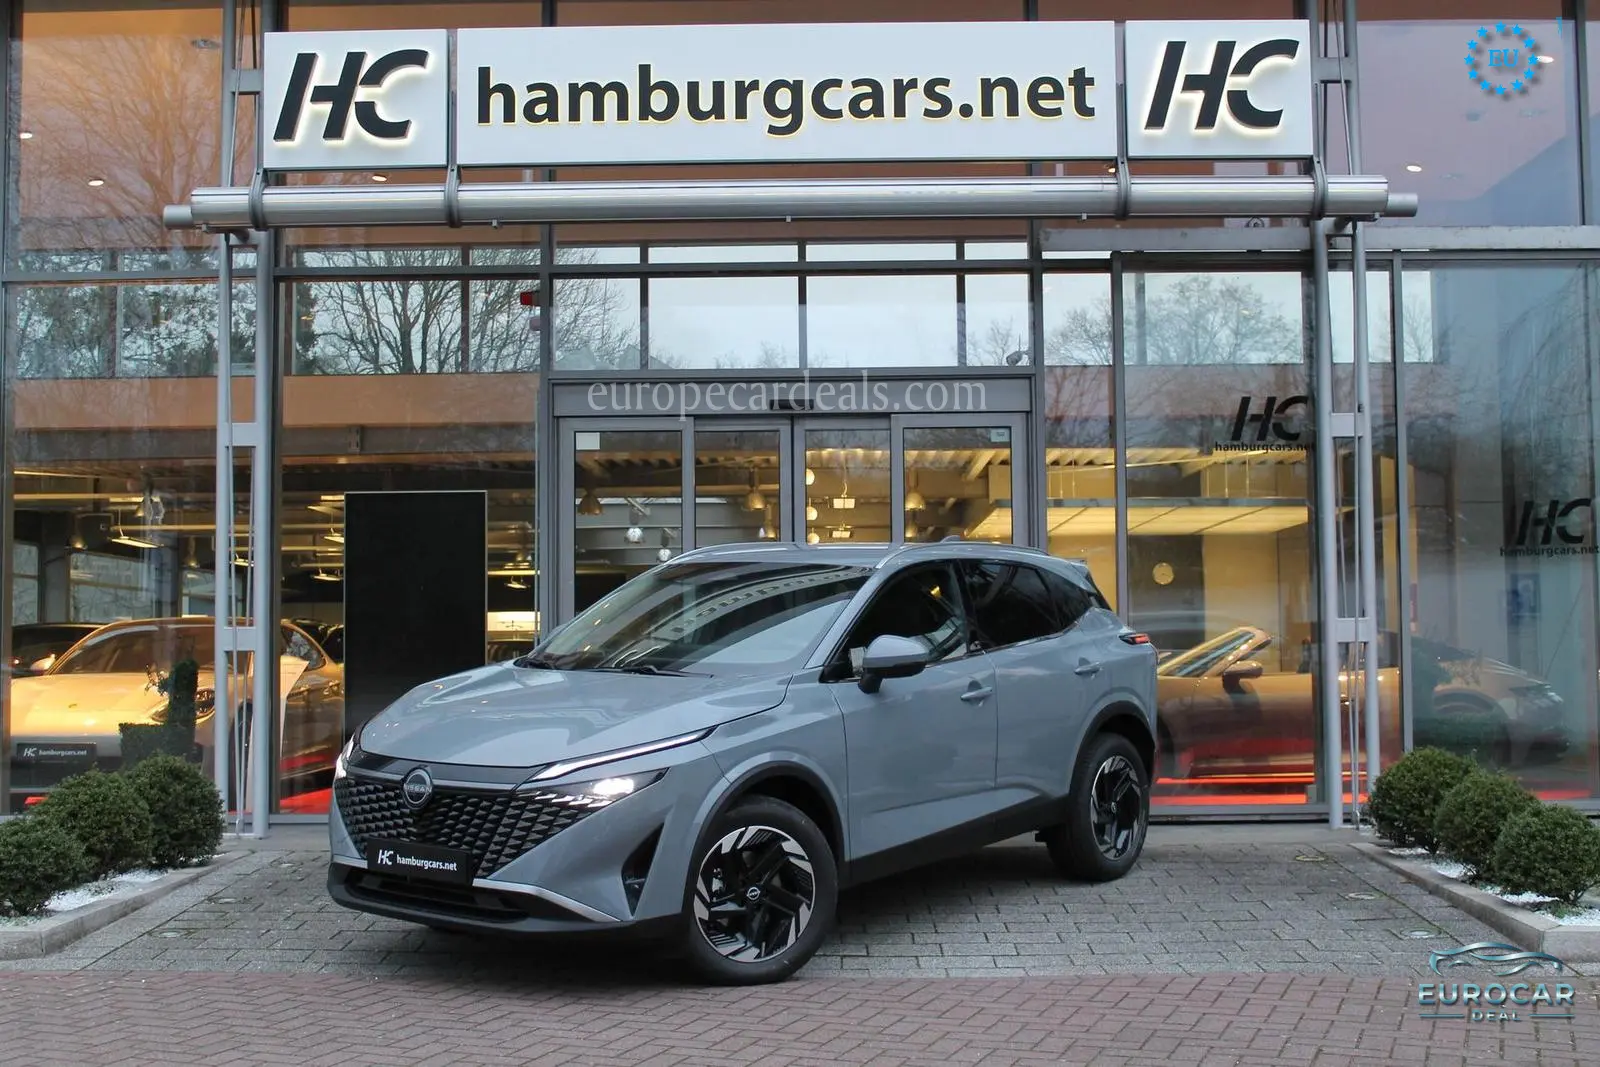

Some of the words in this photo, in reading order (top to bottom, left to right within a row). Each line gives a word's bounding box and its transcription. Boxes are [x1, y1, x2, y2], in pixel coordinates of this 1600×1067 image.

[273, 49, 429, 141] HC
[477, 63, 1095, 136] hamburgcars.net
[1144, 39, 1300, 130] HC
[1231, 396, 1309, 441] HC
[1516, 498, 1592, 545] HC
[23, 747, 37, 757] HC
[377, 849, 394, 865] HC
[396, 854, 457, 871] hamburgcars.net
